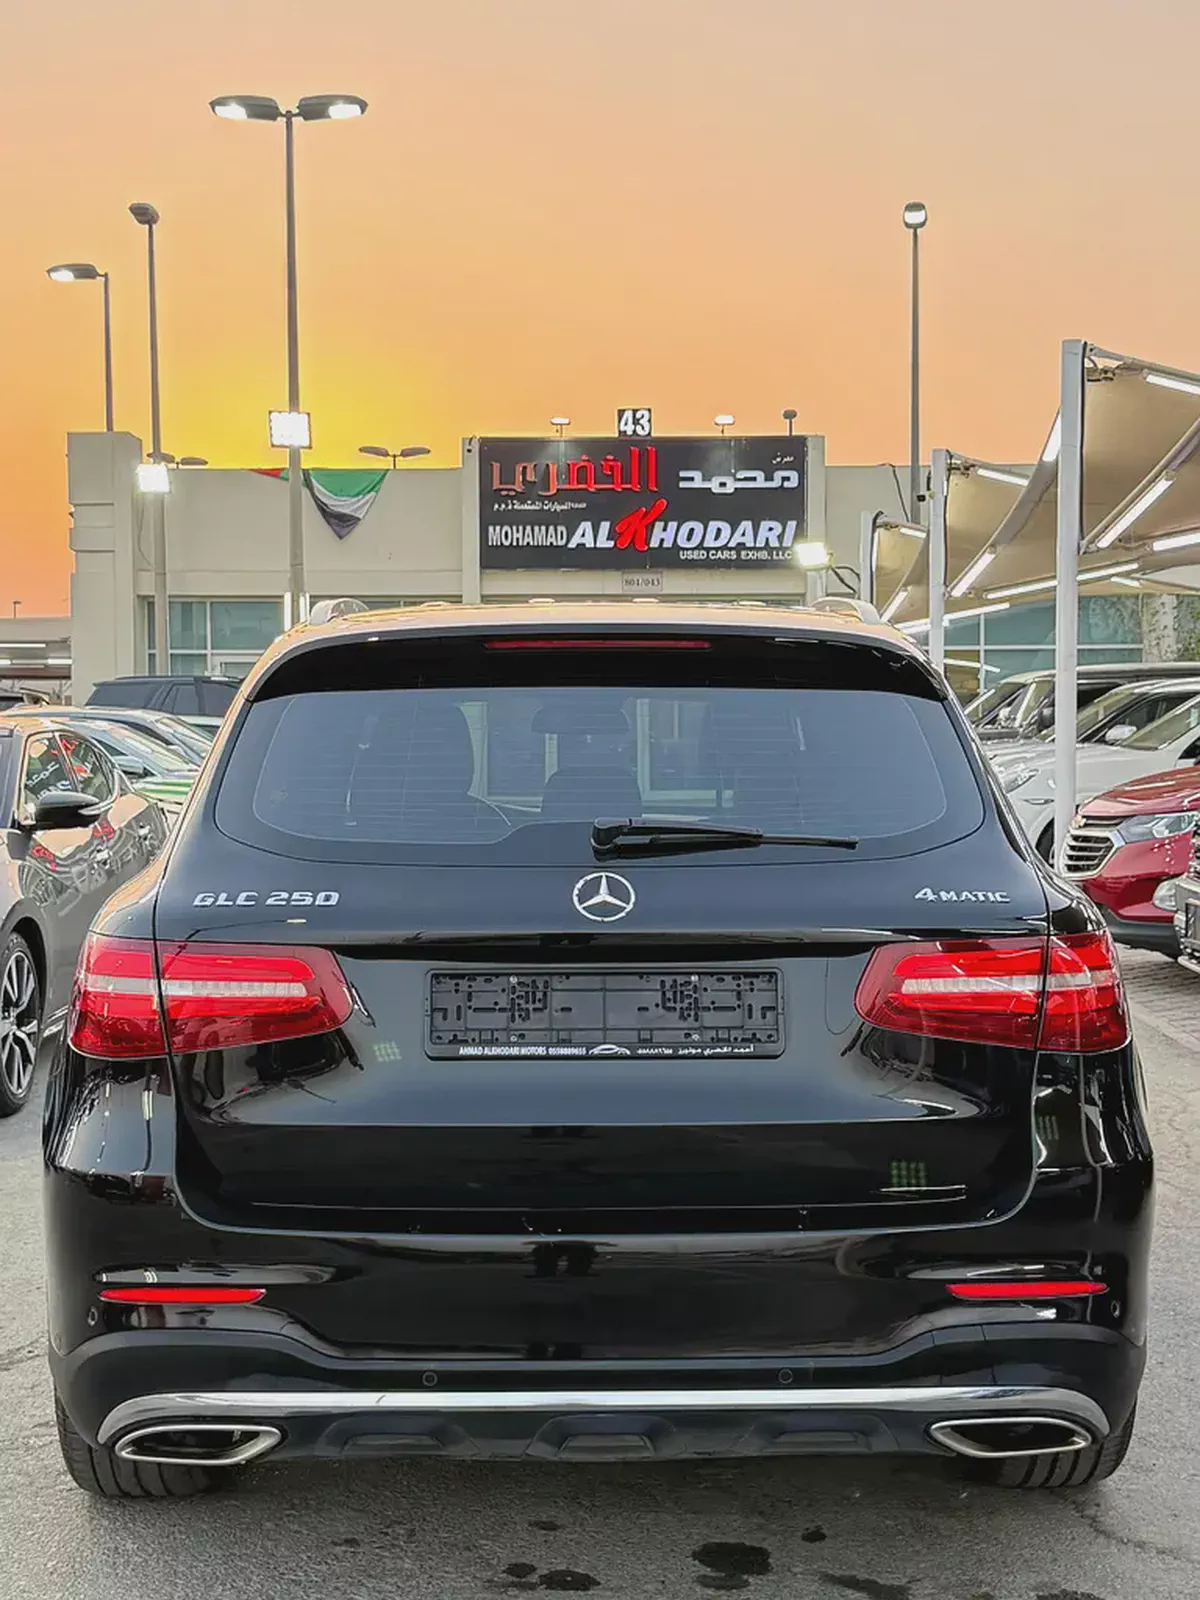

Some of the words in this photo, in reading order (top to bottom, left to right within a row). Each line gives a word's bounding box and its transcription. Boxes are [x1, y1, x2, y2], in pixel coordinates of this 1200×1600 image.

[619, 409, 651, 435] 43
[490, 445, 659, 497] الخضري
[678, 468, 799, 494] محمد
[488, 524, 567, 547] MOHAMAD
[567, 498, 798, 551] ALKHODARI
[679, 550, 707, 560] USED
[709, 550, 737, 560] CARS
[740, 550, 771, 560] EXHB.
[773, 550, 793, 560] LLC
[192, 891, 258, 908] GLC
[265, 891, 341, 907] 250
[914, 886, 1011, 904] 4MATIC
[459, 1046, 483, 1056] AHMAD
[521, 1046, 547, 1056] MOTORS
